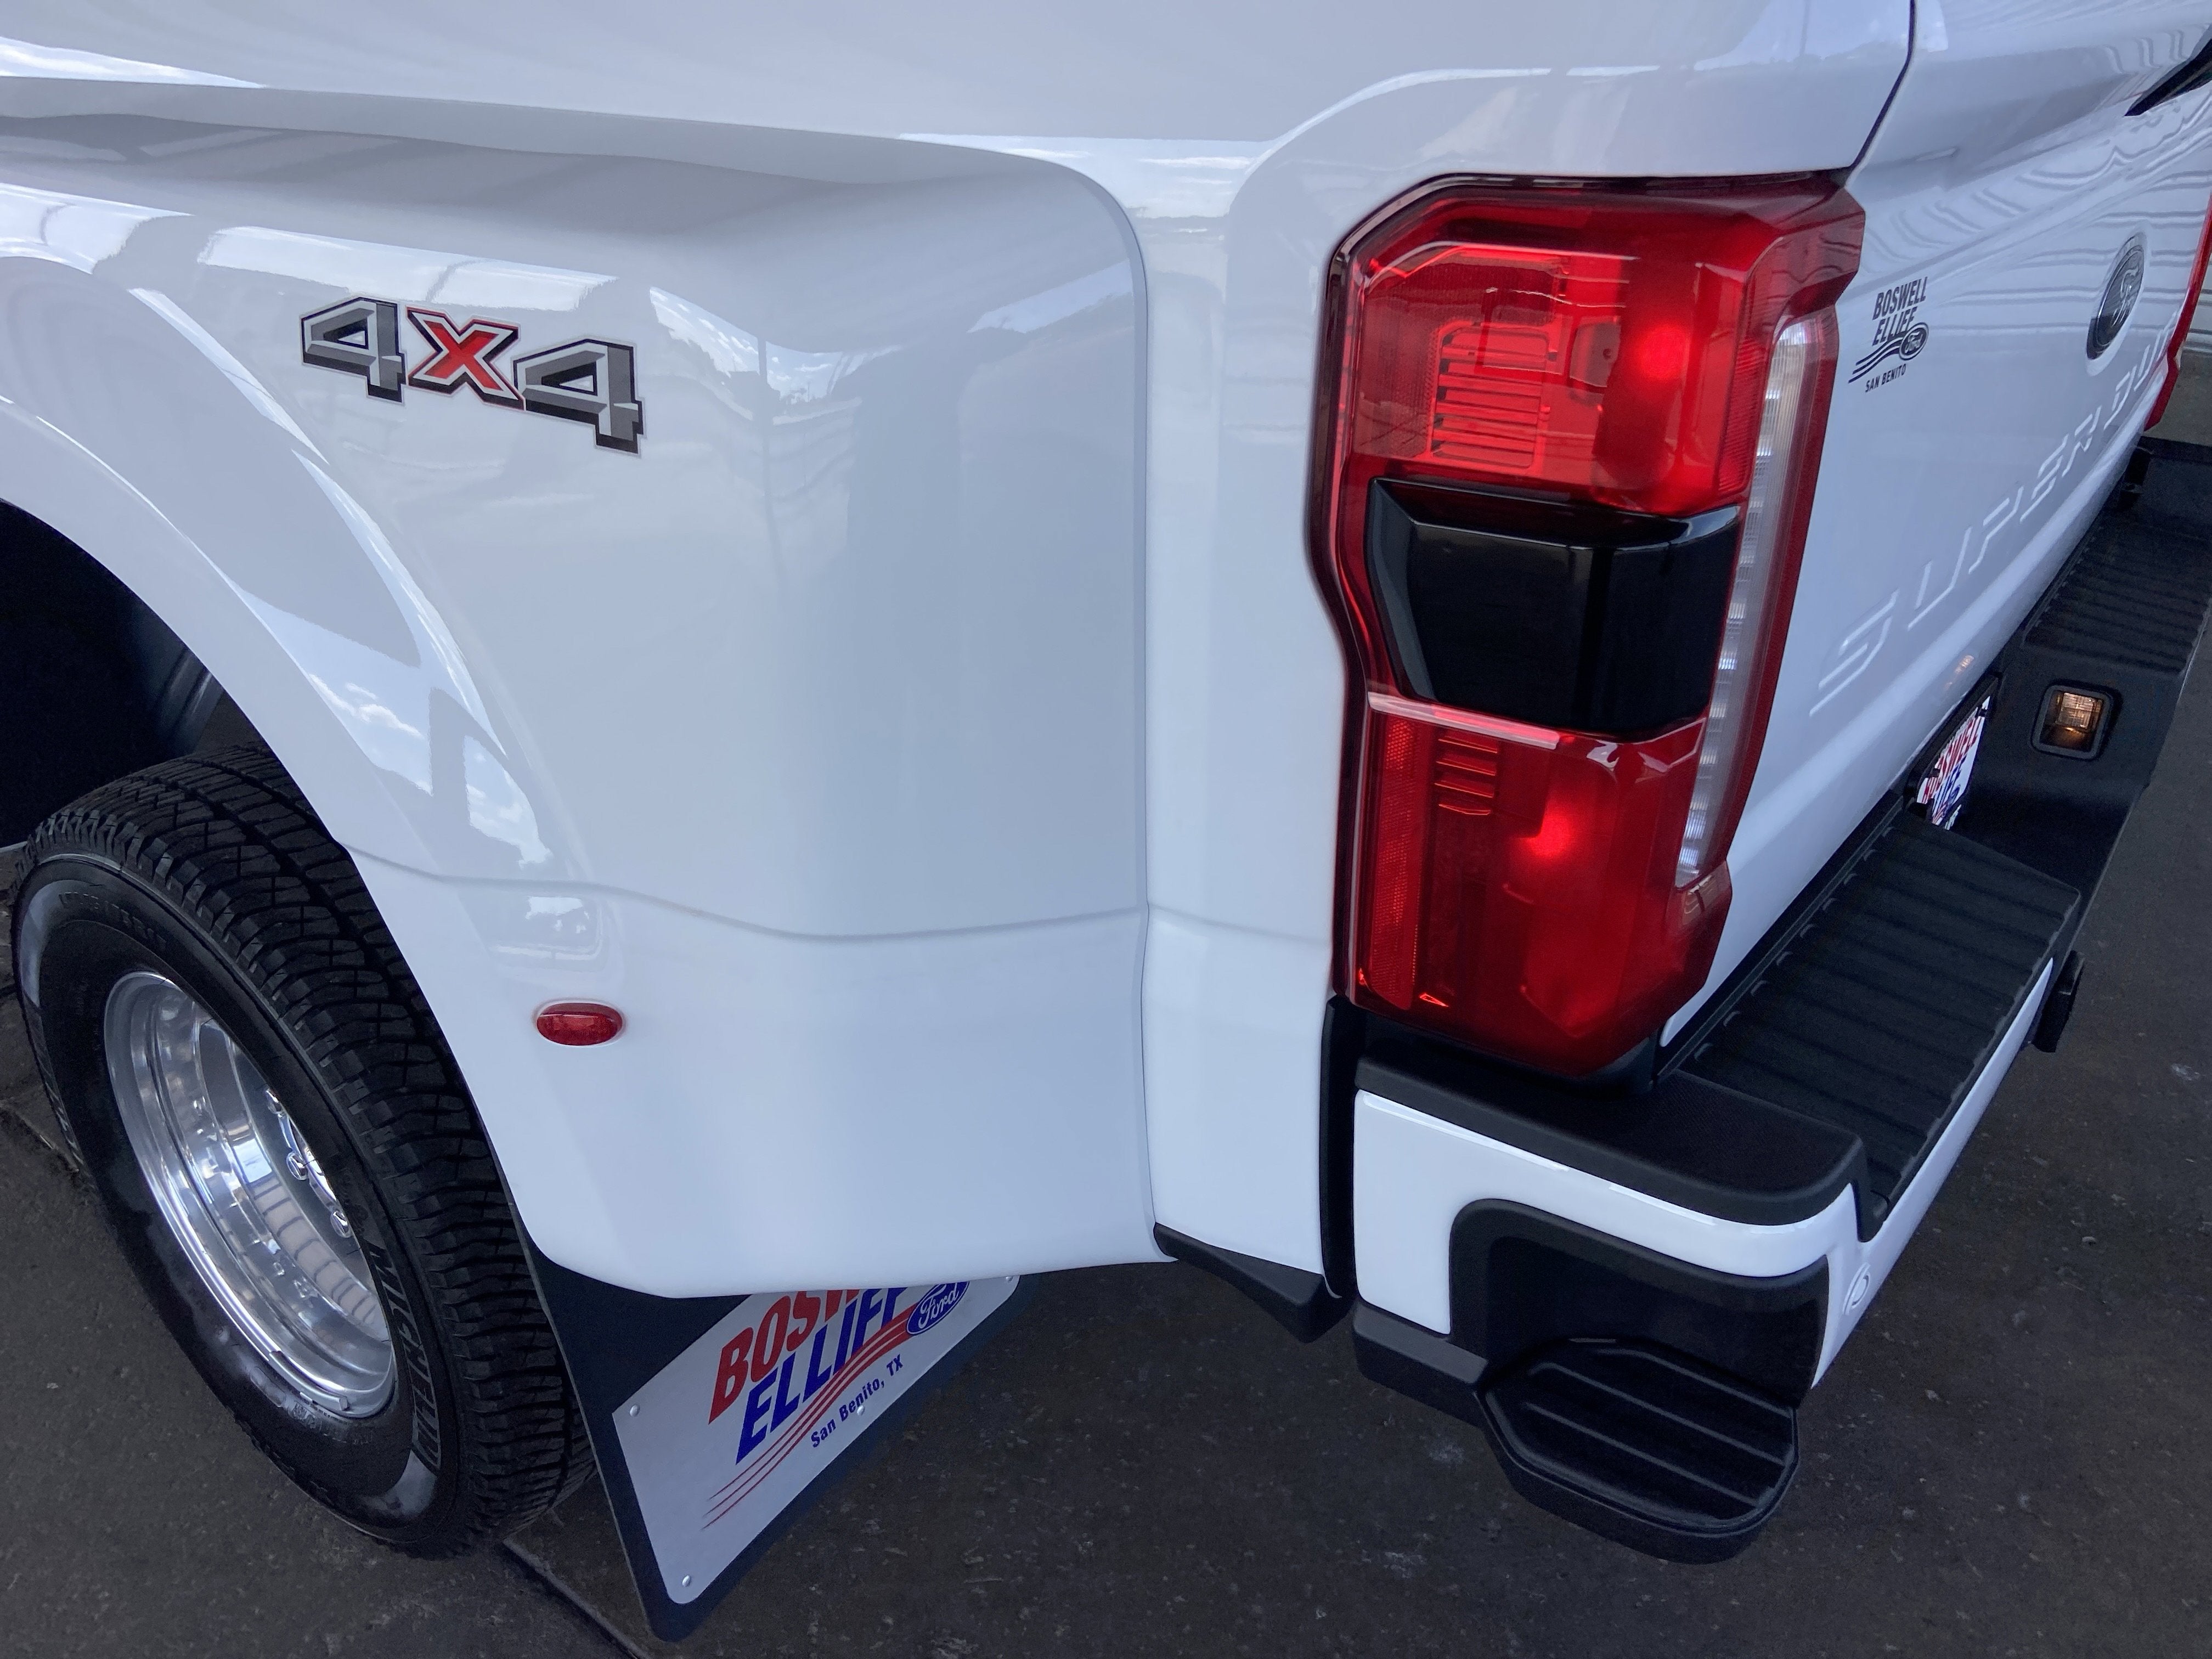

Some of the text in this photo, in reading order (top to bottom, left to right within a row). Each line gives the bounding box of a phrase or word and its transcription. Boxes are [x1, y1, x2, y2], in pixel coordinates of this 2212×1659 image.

[1872, 276, 1928, 320] BOSWELL
[1865, 363, 1907, 393] SAN BENITO
[1809, 405, 2102, 718] SUPER
[918, 1283, 960, 1329] Ford
[810, 1353, 904, 1448] San Benito, TX
